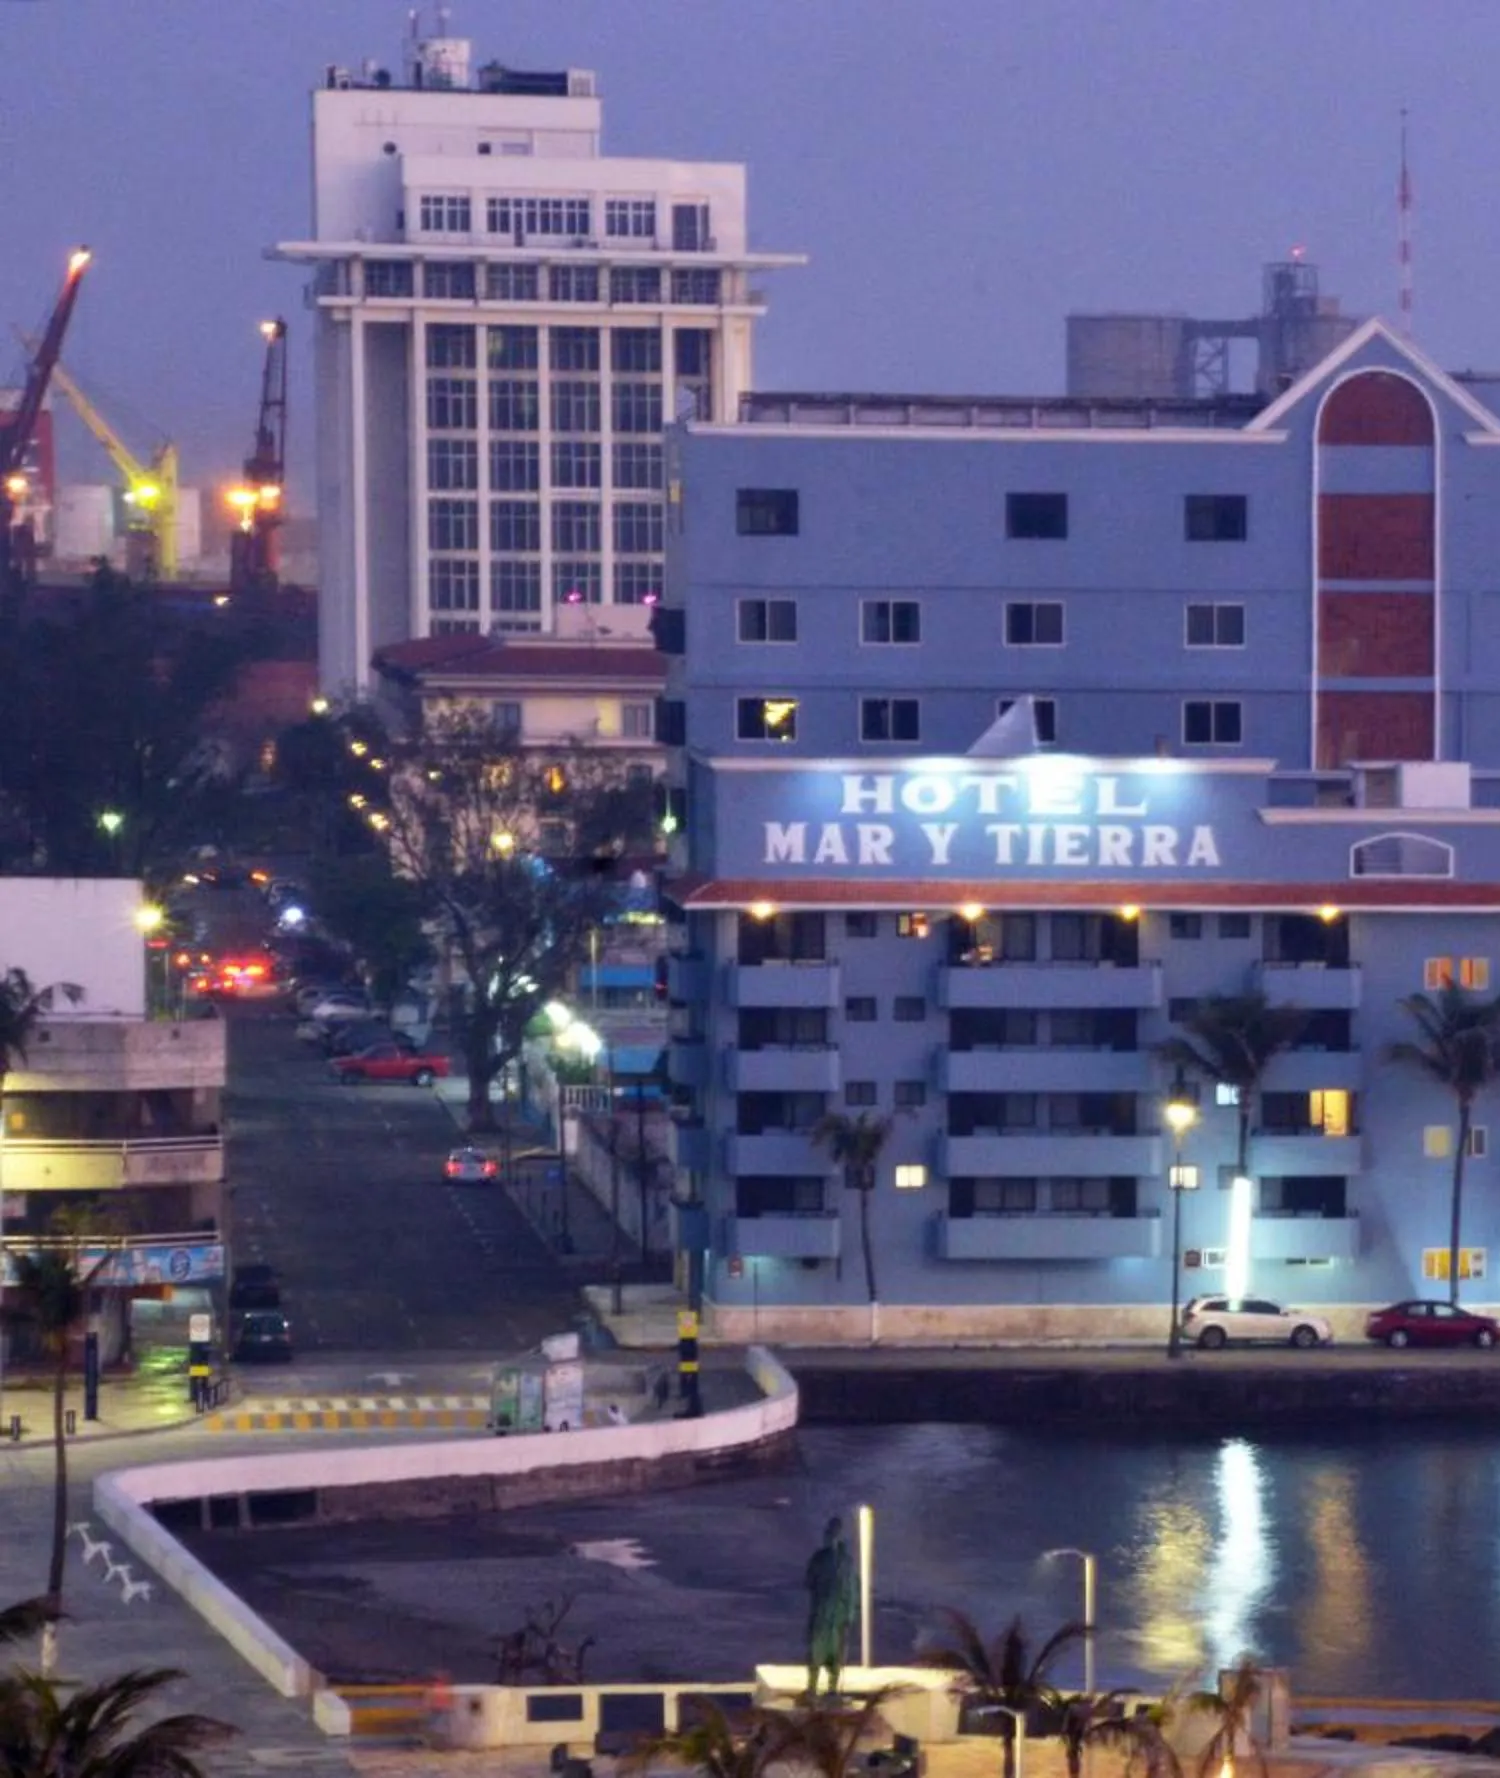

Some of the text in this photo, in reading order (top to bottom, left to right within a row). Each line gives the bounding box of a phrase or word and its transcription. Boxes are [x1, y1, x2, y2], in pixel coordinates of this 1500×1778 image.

[840, 774, 1148, 815] HOTEL
[764, 822, 1221, 866] MAR Y TIERRA
